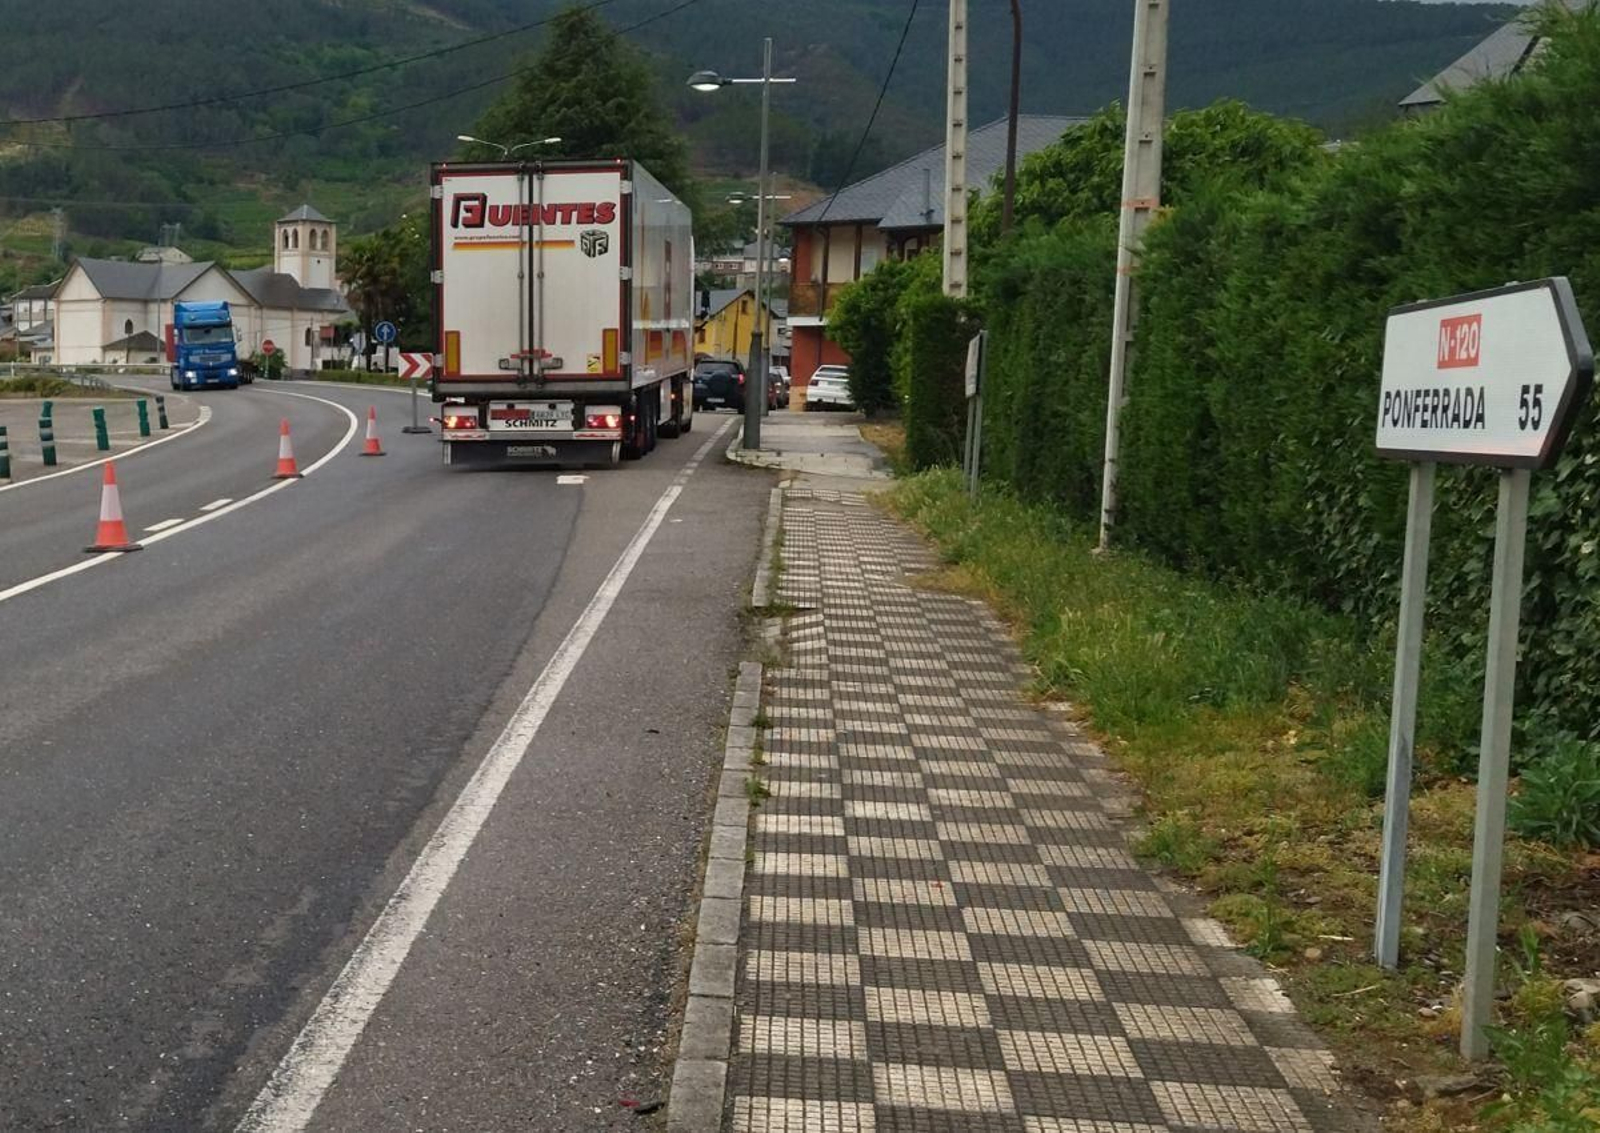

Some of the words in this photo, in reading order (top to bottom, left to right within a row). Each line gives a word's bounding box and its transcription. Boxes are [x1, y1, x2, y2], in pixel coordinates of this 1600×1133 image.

[1440, 321, 1479, 362] N-120
[505, 419, 557, 428] SCHMITZ
[1382, 386, 1486, 430] PONFERRADA
[1518, 384, 1544, 431] 55
